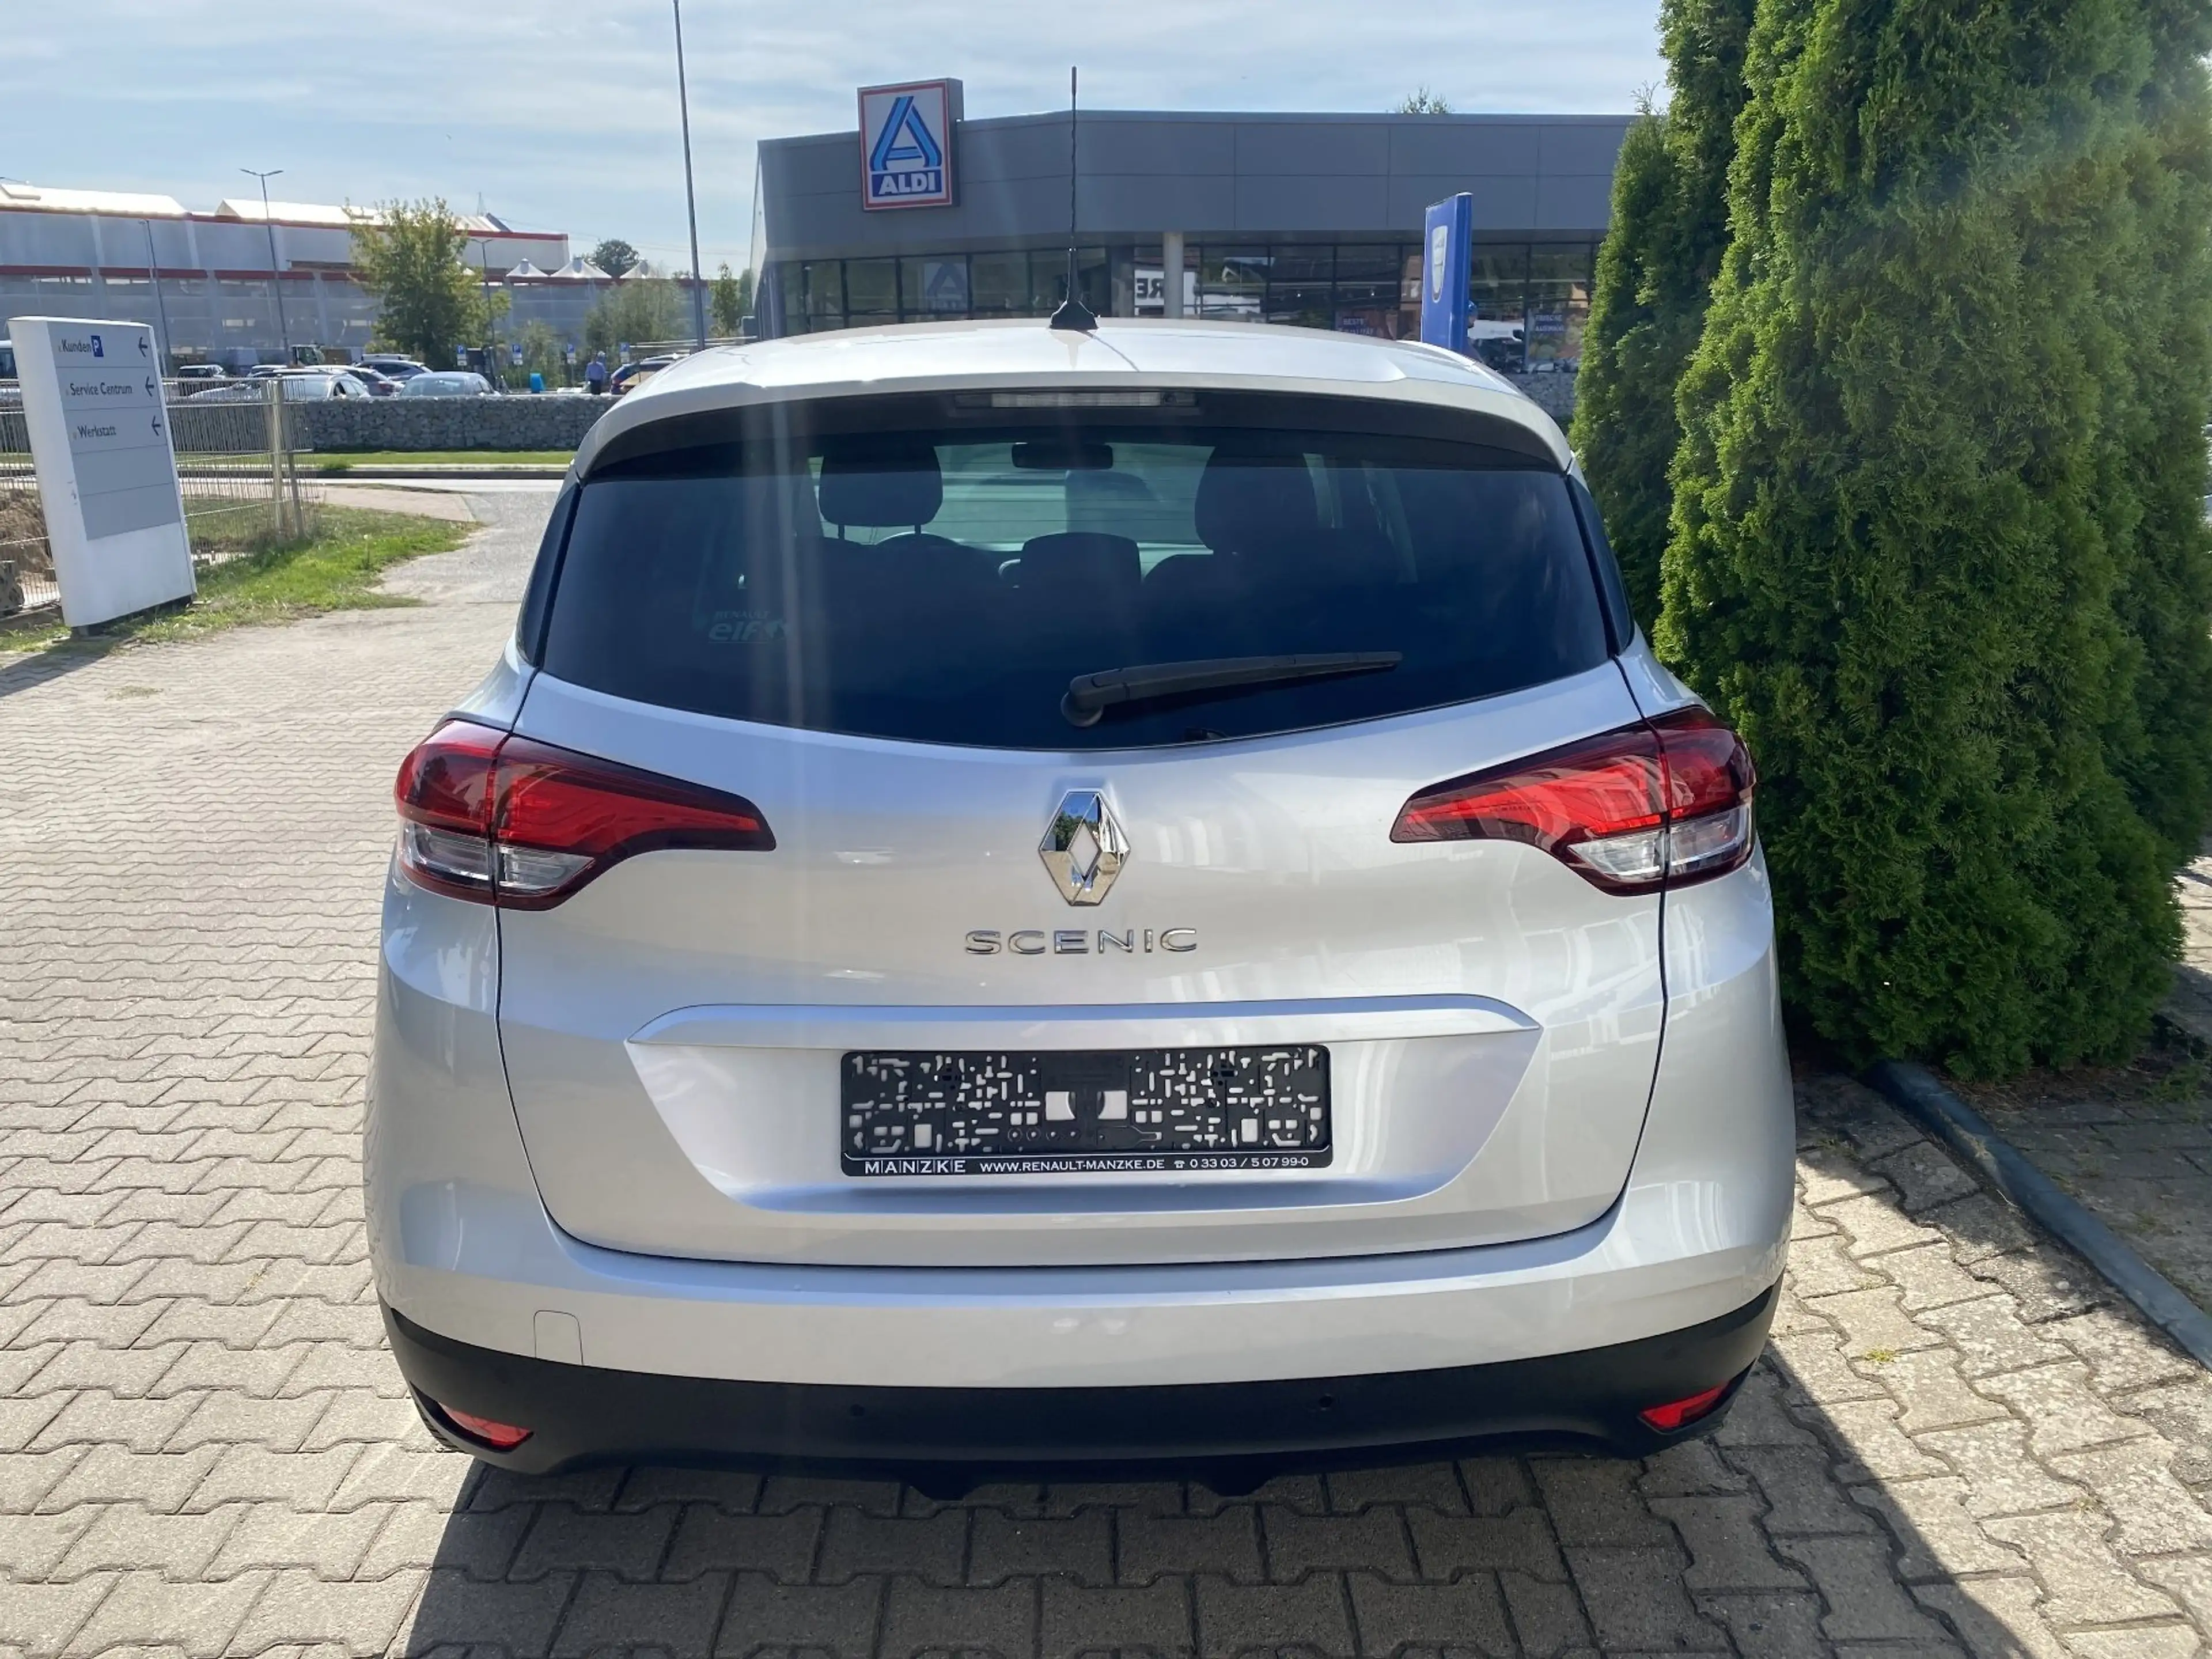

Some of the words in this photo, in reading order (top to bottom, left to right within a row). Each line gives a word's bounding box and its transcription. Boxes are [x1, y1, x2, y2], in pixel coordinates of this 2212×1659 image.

[878, 172, 935, 195] ALDI
[60, 339, 92, 353] Kunden
[70, 382, 99, 396] Service
[100, 382, 133, 395] Centrum
[77, 425, 117, 438] Werkstatt
[709, 621, 762, 641] elf
[965, 928, 1197, 955] SCENIC
[980, 1159, 1165, 1172] WWW.RENAULT-MANZKE.DE
